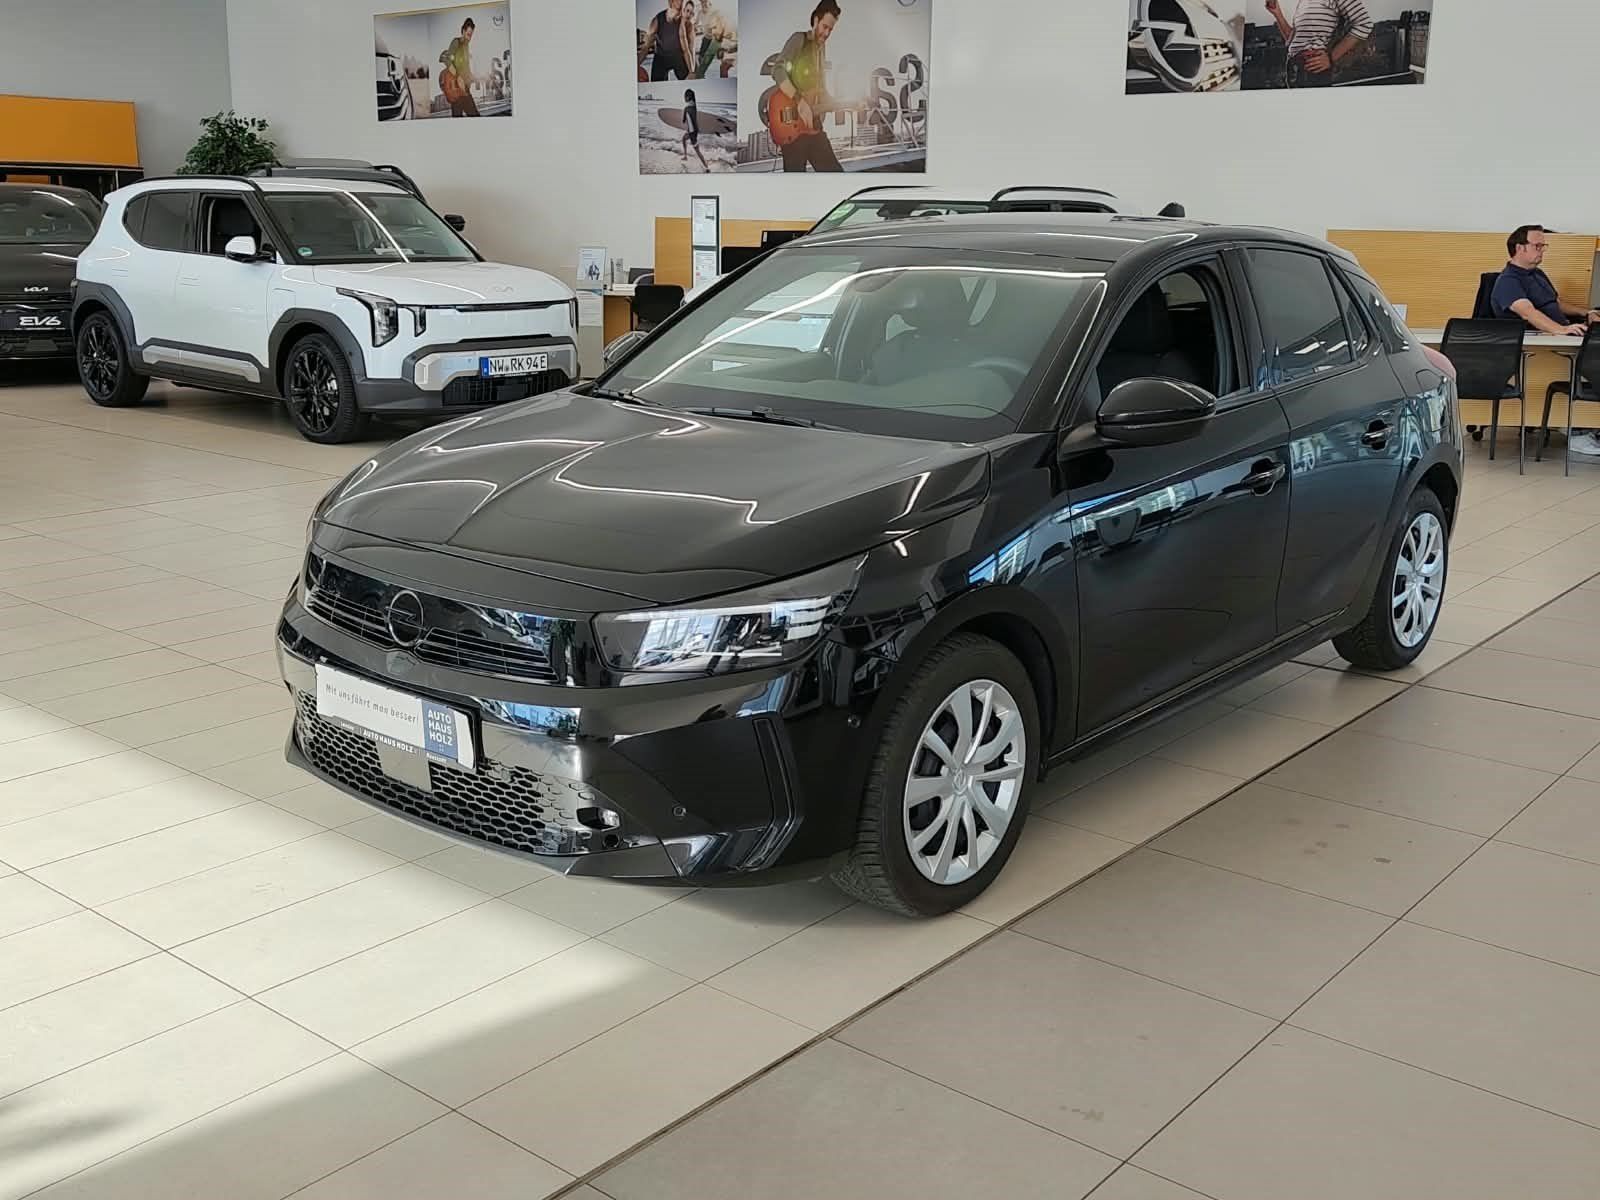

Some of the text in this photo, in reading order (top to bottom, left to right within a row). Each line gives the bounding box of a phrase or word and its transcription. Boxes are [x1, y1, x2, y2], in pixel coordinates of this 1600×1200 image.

[19, 316, 62, 326] EV6
[489, 359, 504, 373] NW
[510, 358, 524, 372] RK
[325, 683, 337, 696] Mit
[338, 690, 351, 702] uns
[372, 703, 389, 715] man
[427, 709, 452, 725] AUTO
[428, 719, 453, 736] HAUS
[429, 730, 454, 747] HOLZ
